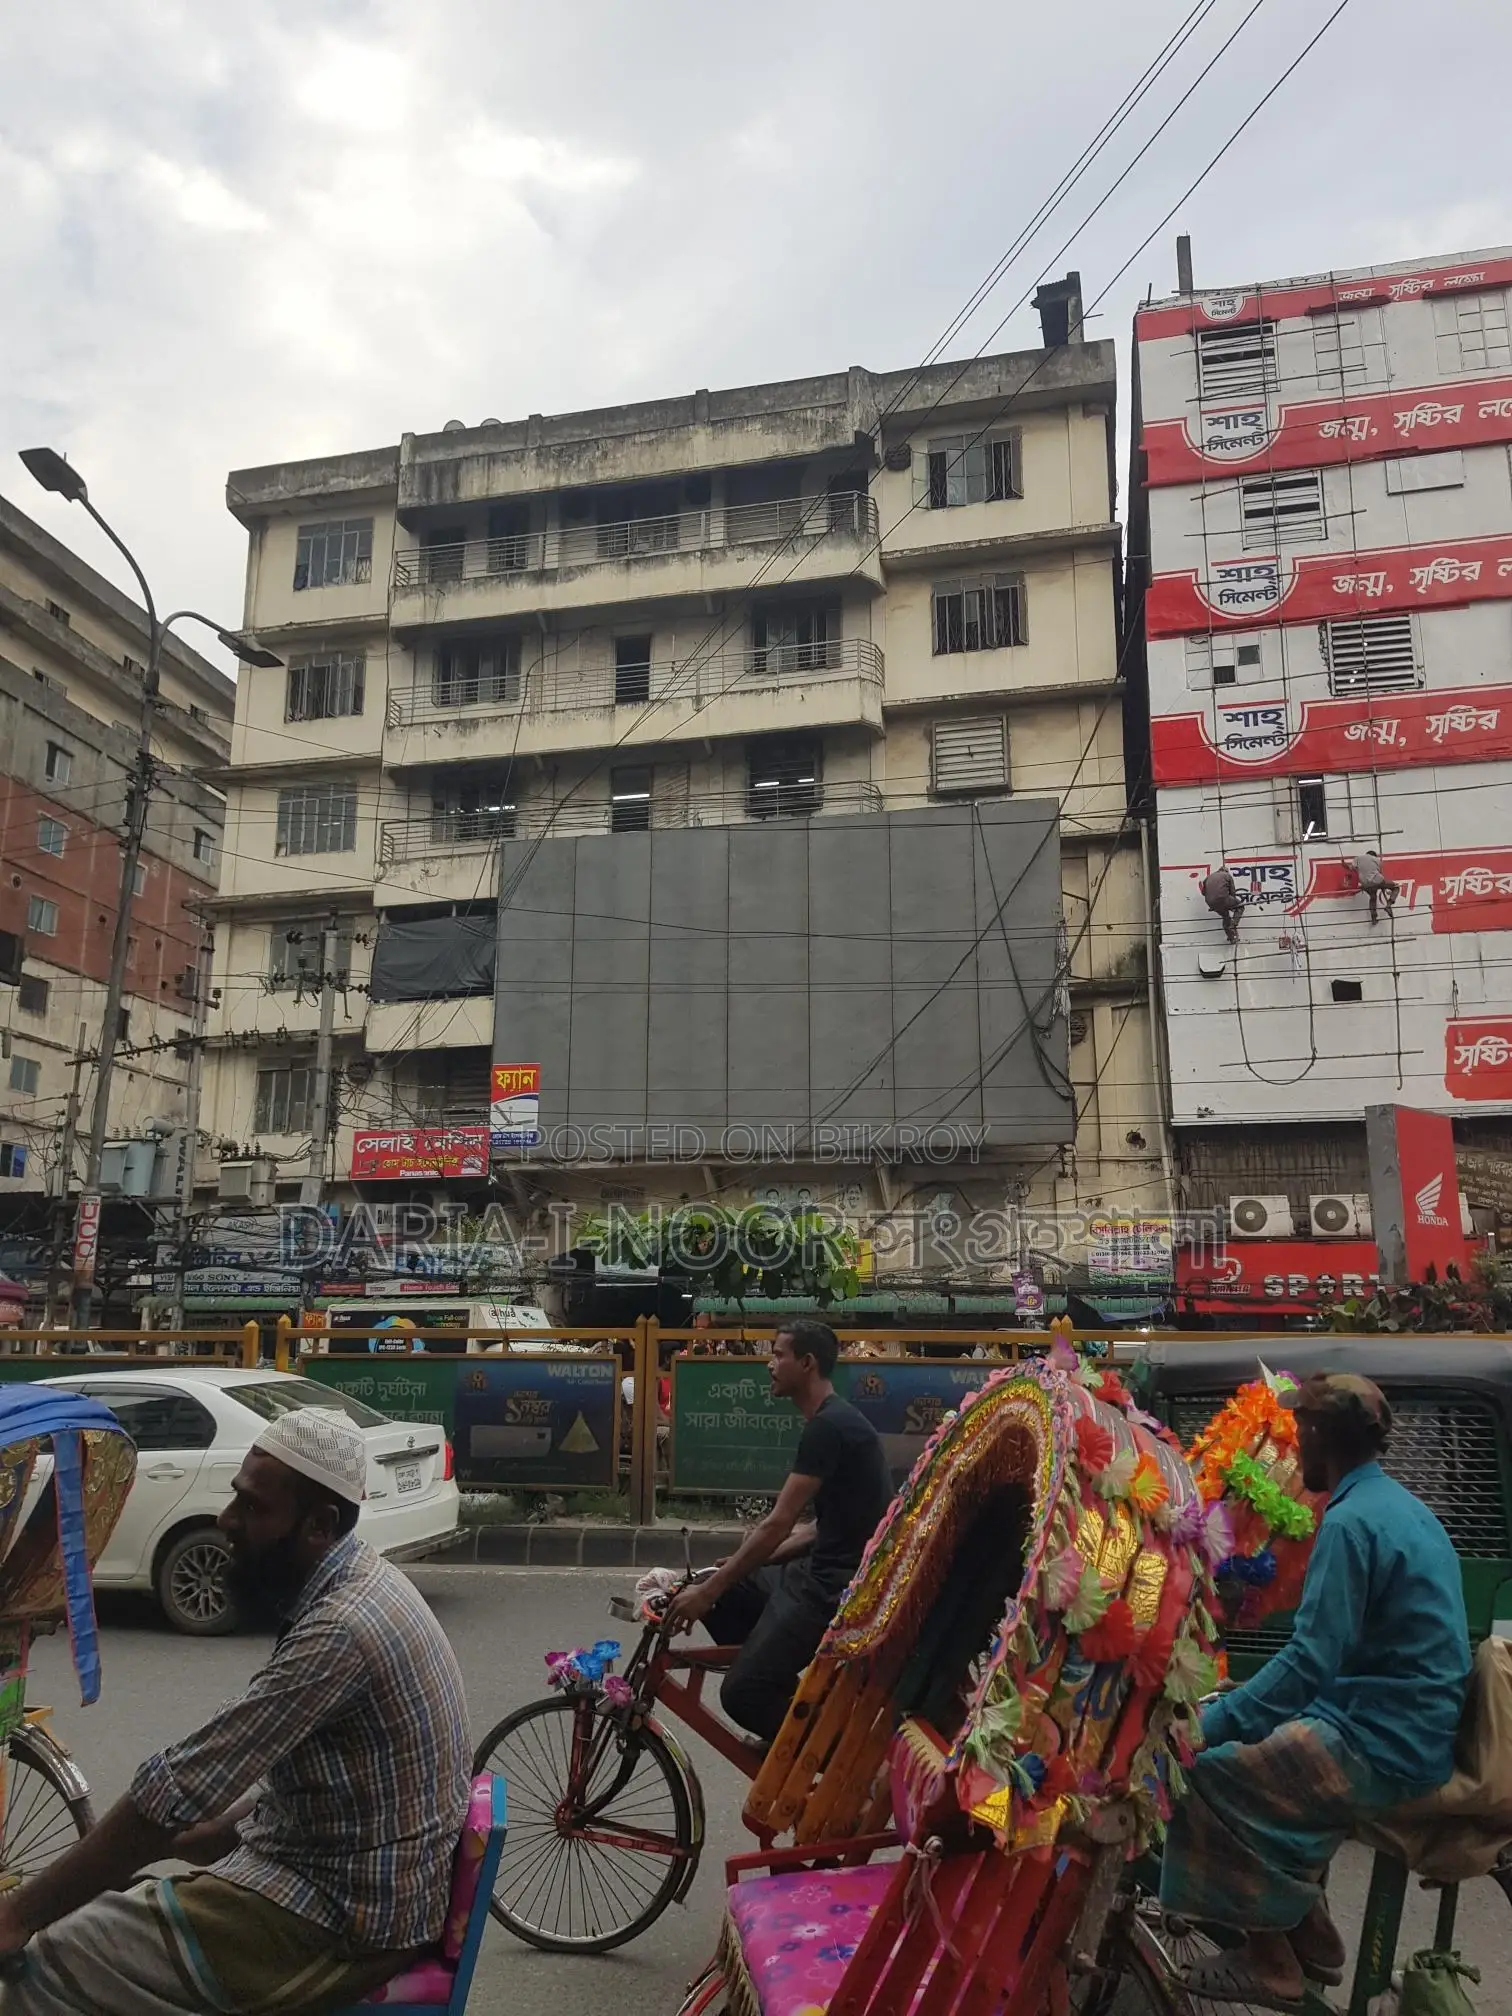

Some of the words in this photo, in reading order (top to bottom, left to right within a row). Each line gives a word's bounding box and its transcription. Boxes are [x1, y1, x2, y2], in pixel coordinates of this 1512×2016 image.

[1394, 402, 1464, 437] সৃষ্টির
[1207, 431, 1265, 452] সিমেন্ট
[1332, 571, 1394, 597] জন্ম,
[1409, 557, 1483, 594] সৃষ্টির
[1218, 583, 1278, 605] সিমেন্ট
[1425, 705, 1500, 743] সৃষ্টির
[1224, 728, 1287, 751] সিমেন্ট
[1454, 1036, 1512, 1076] সৃষ্টি
[495, 1067, 537, 1092] ফ্যান
[356, 1133, 417, 1155] সেলাই
[77, 1202, 99, 1258] UCC
[1417, 1214, 1448, 1226] HONDA
[207, 1273, 240, 1281] SONY
[546, 1363, 614, 1378] WALTON
[708, 1377, 756, 1403] একটি
[684, 1410, 720, 1430] সারা
[723, 1406, 793, 1432] জীবনের
